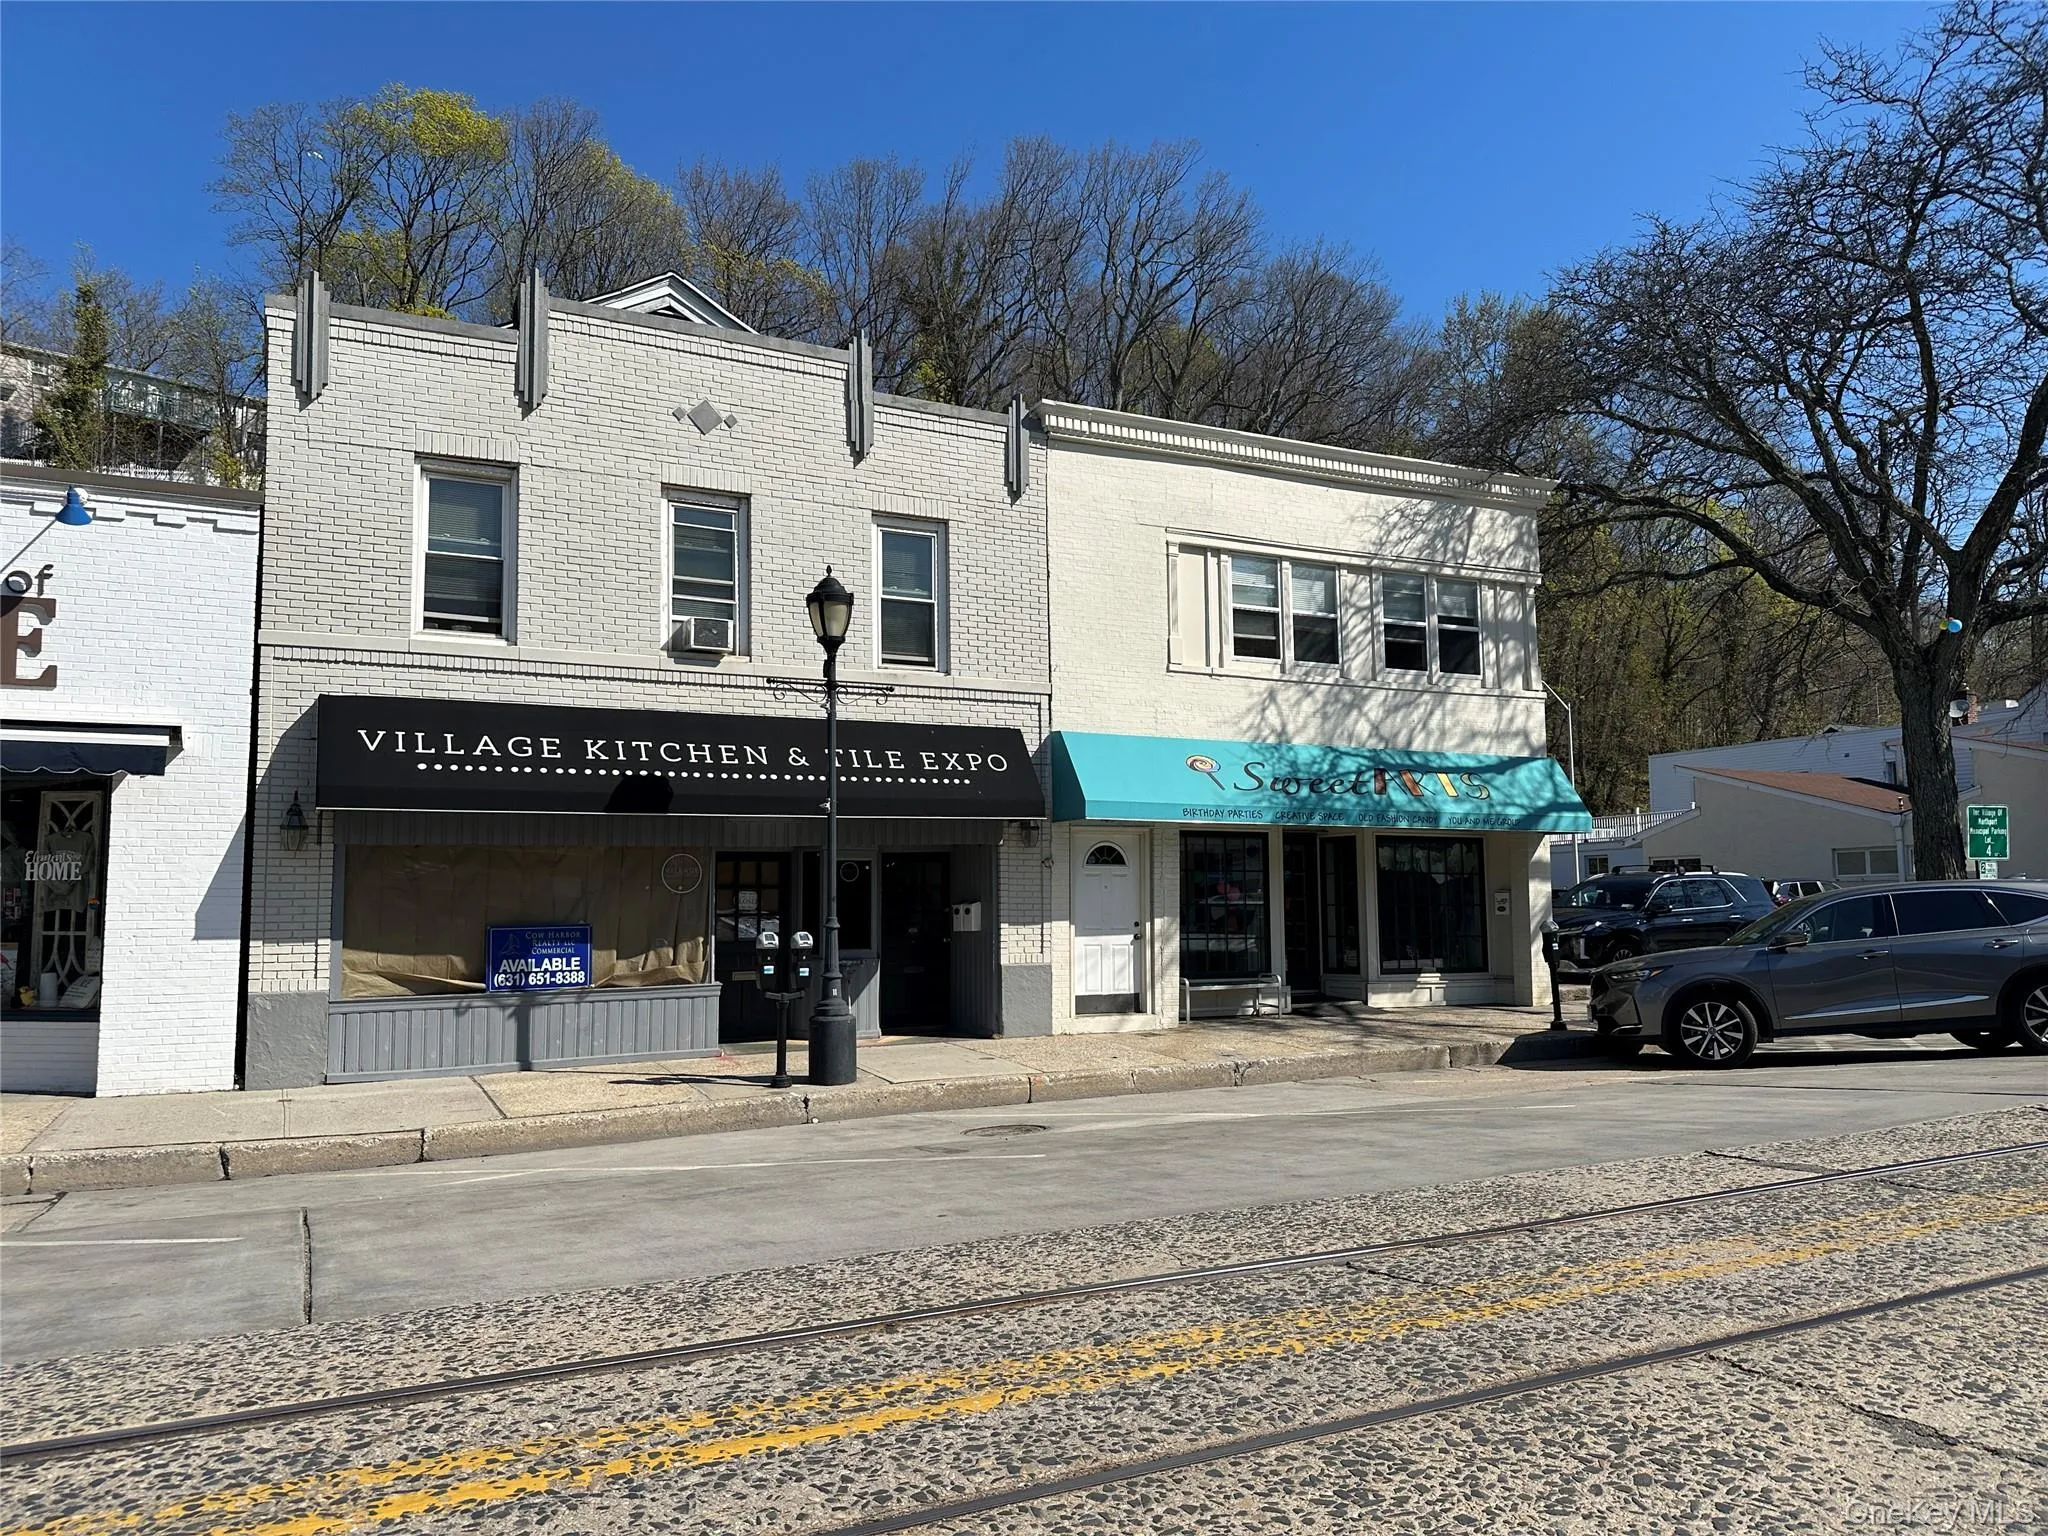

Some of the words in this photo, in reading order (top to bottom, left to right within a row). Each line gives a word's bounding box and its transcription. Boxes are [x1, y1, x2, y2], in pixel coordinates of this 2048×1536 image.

[6, 564, 54, 597] of
[357, 729, 562, 759] VILLAGE
[585, 739, 767, 766] KITCHEN
[788, 746, 810, 767] &
[922, 751, 1009, 773] EXPO
[1182, 807, 1226, 818] BIRTHDAY
[1227, 808, 1264, 819] PARTIES
[1274, 810, 1316, 820] CREATIVE
[1317, 811, 1345, 821] SPACE
[1358, 813, 1374, 823] OLD
[1376, 813, 1410, 824] FASHION
[1412, 814, 1438, 824] CANDY
[1447, 815, 1463, 825] YOU
[1464, 816, 1481, 825] AND
[1986, 845, 1991, 856] 4
[24, 861, 82, 881] HOME
[531, 946, 575, 955] COMMERCIAL
[499, 956, 581, 973] AVAILABLE
[493, 972, 526, 988] (631)
[528, 970, 586, 986] 651-8388
